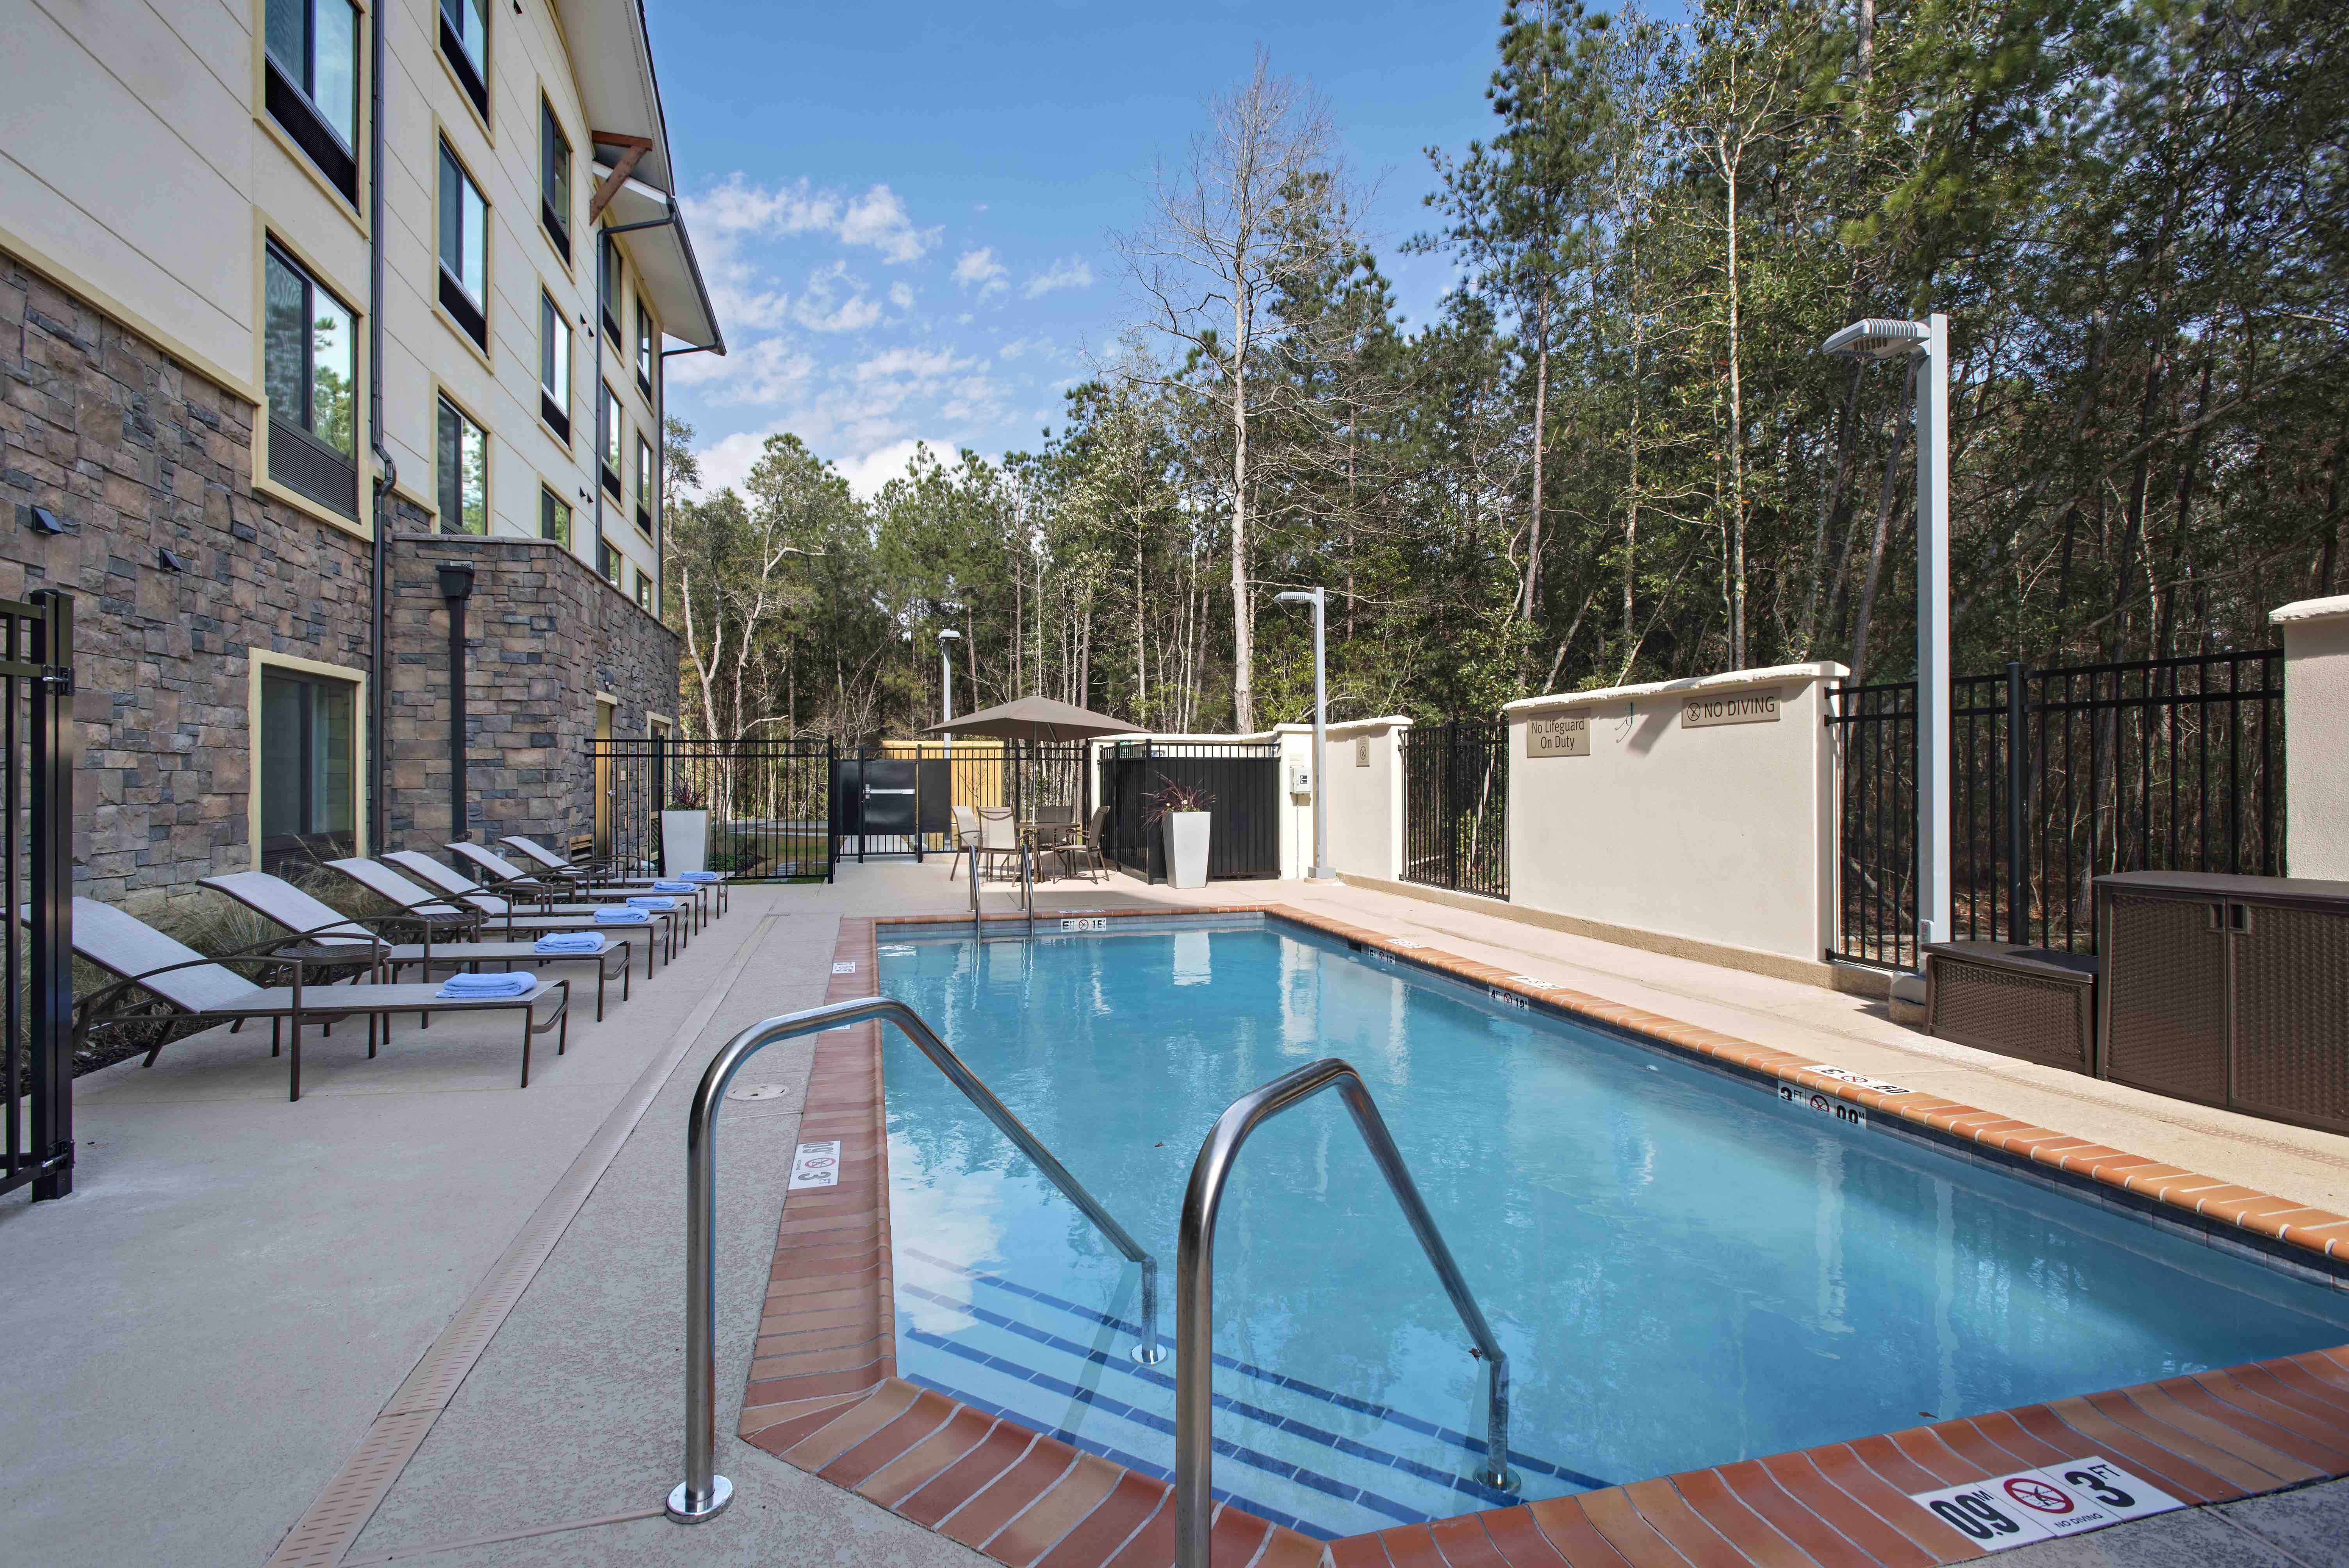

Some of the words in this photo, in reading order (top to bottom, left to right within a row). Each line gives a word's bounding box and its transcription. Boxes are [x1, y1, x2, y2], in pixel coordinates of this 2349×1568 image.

[1704, 702, 1723, 718] NO
[1728, 696, 1775, 716] DIVING
[1532, 722, 1542, 734] No
[1545, 716, 1584, 735] Lifeguard
[1541, 736, 1552, 748] On
[1555, 736, 1575, 750] Duty
[1793, 1090, 1803, 1100] FT
[2087, 1464, 2121, 1479] FT
[1971, 1490, 1994, 1501] M
[2064, 1471, 2135, 1507] 3
[2070, 1513, 2104, 1524] DIVING
